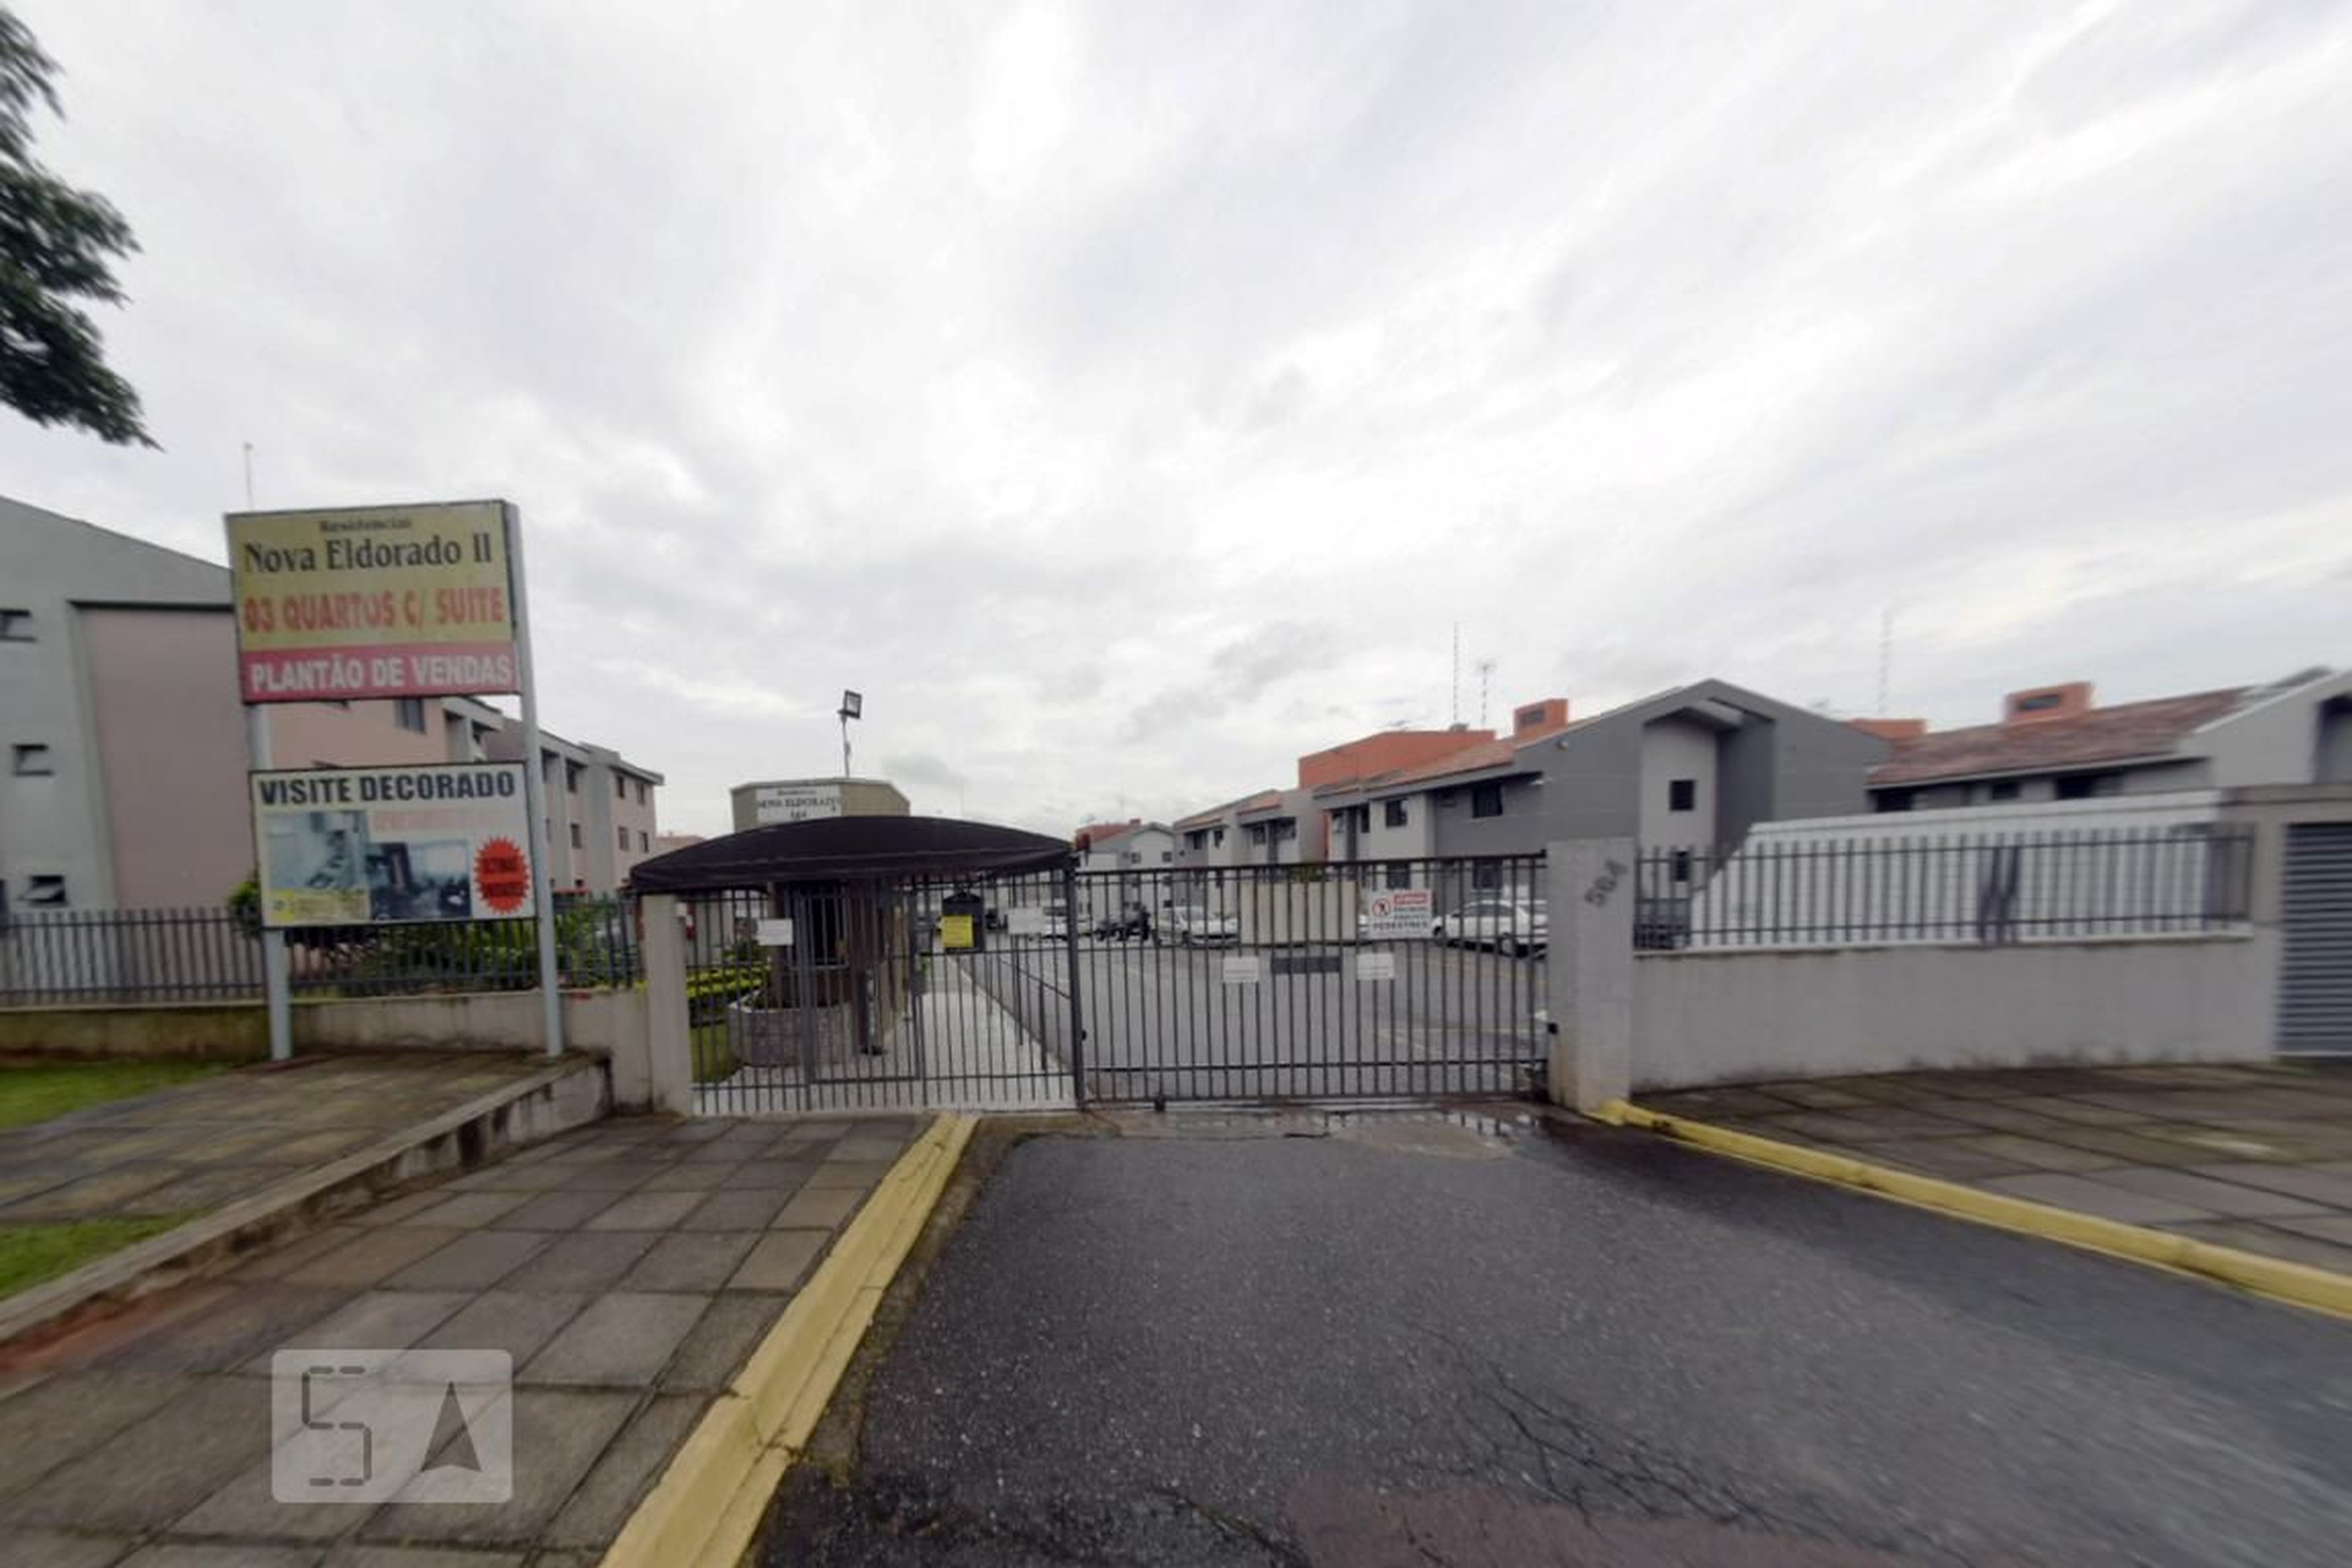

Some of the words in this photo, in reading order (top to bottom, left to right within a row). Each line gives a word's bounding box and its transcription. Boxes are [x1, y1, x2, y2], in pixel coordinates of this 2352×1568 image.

[246, 543, 317, 572] Nova
[326, 535, 461, 570] Eldorado
[246, 597, 275, 633] 03
[284, 590, 394, 631] QUARTOS
[251, 654, 363, 692] PLANTÃO
[371, 657, 404, 687] DE
[411, 653, 513, 686] VENDAS
[259, 777, 351, 805] VISITE
[359, 771, 514, 802] DECORADO
